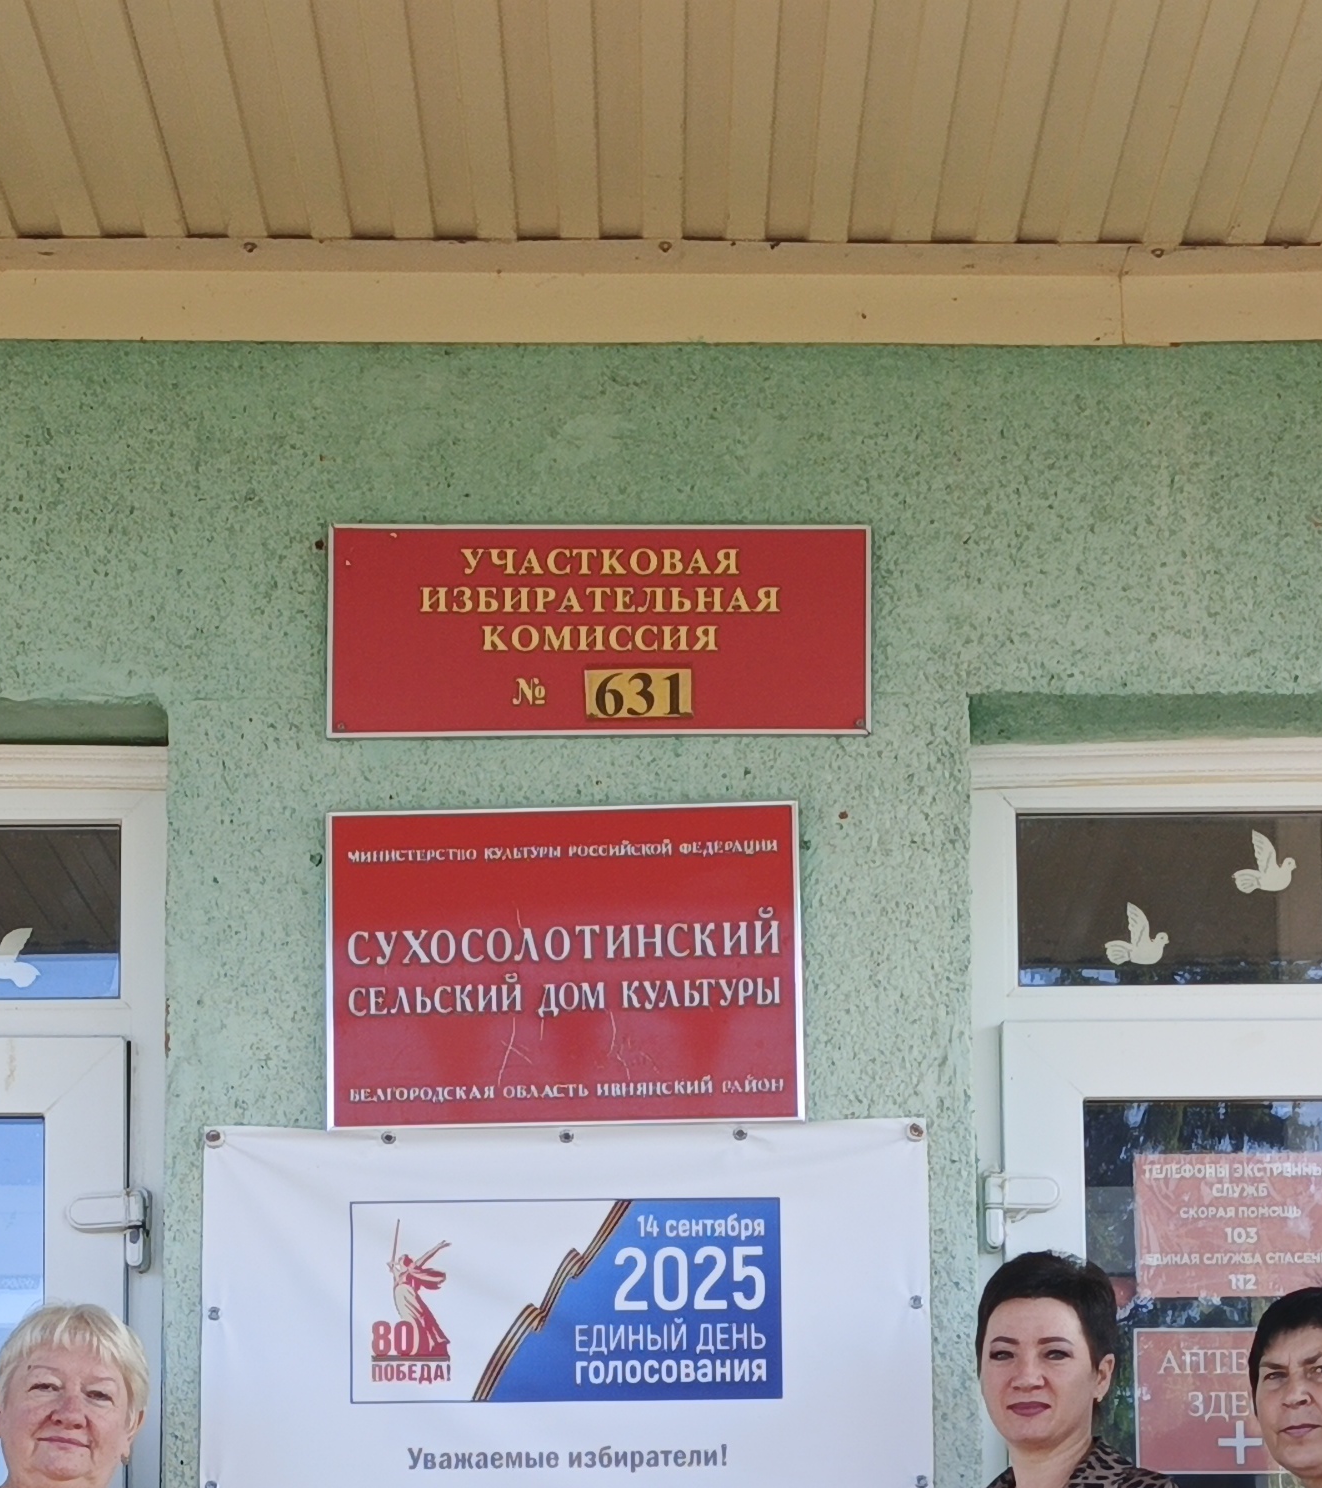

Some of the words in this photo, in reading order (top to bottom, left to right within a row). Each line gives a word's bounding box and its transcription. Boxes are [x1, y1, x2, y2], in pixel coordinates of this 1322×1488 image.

[461, 548, 739, 575] УЧАСТКОВАЯ
[420, 587, 780, 612] ИЗБИРАТЕЛЬНАЯ
[482, 625, 718, 651] КОМИССИЯ
[513, 678, 545, 704] №
[595, 671, 684, 717] 631
[348, 849, 476, 862] МИНИСТЕРСТВО
[485, 846, 561, 861] КУЛЬТУРЫ
[569, 840, 672, 856] РОССИЙСКОЙ
[679, 839, 777, 857] ФЕДЕРАЦИИ
[348, 907, 780, 964] СУХОСОЛОТИНСКИЙ
[349, 973, 521, 1016] СЕЛЬСКИЙ
[538, 982, 606, 1017] ДОМ
[622, 977, 780, 1009] КУЛЬТУРЫ
[350, 1085, 494, 1102] БЕЛГОРОДСКАЯ
[503, 1081, 589, 1098] ОБЛАСТЬ
[597, 1076, 712, 1097] ИВНЯНСКИЙ
[722, 1075, 783, 1093] РАЙОН
[637, 1213, 659, 1237] 14
[666, 1213, 764, 1240] сентября
[615, 1246, 765, 1311] 2025
[371, 1320, 415, 1357] 80
[576, 1319, 686, 1356] ЕДИНЫЙ
[696, 1323, 766, 1354] ДЕНЬ
[372, 1361, 451, 1384] ПОБЕДА!
[576, 1359, 766, 1384] голосования
[1158, 1350, 1249, 1375] АПТЕ
[1188, 1391, 1250, 1422] ЗДЕ
[408, 1448, 559, 1469] Уважаемые
[569, 1444, 727, 1473] избиратели!
